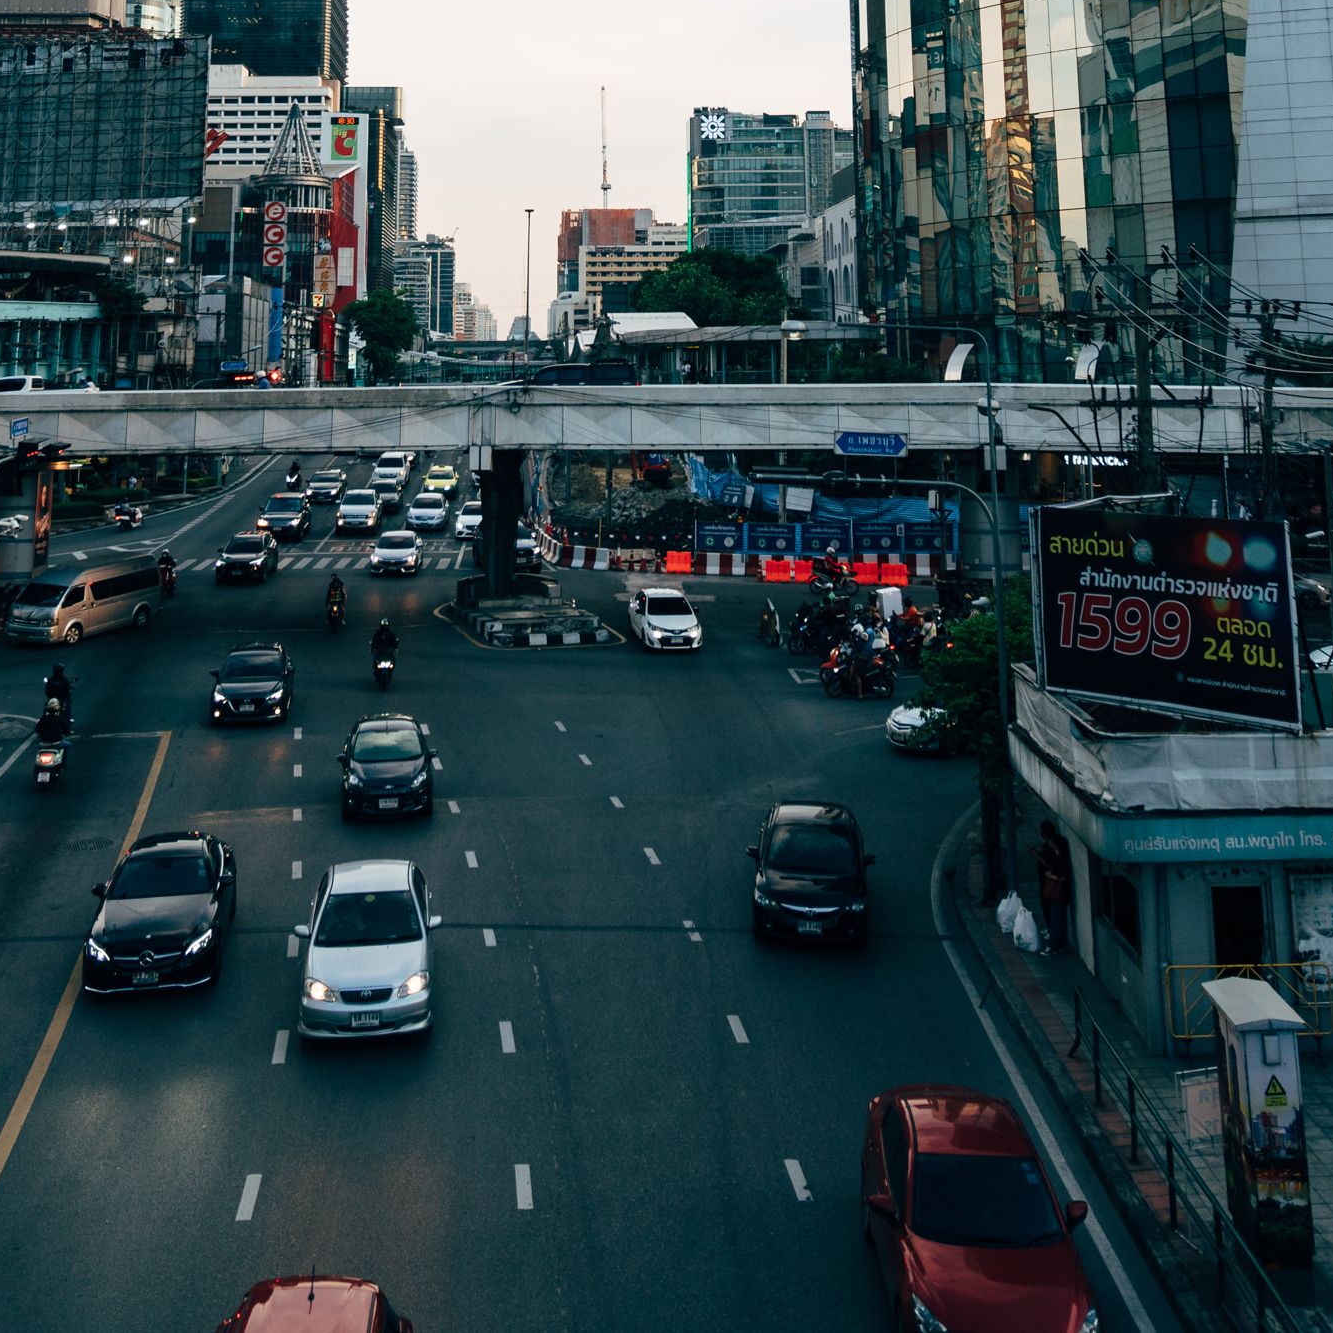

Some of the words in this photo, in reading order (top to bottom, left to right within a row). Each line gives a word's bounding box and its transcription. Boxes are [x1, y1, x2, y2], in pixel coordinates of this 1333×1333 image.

[1049, 531, 1125, 557] สายด่วน
[1079, 566, 1278, 604] สำนักงานตำรวจแห่งชาติ
[1057, 591, 1191, 660] 1599
[1216, 616, 1271, 638] ตลอด
[1203, 637, 1233, 663] 24
[1243, 644, 1284, 670] ชม.
[1299, 829, 1327, 847] โทร.
